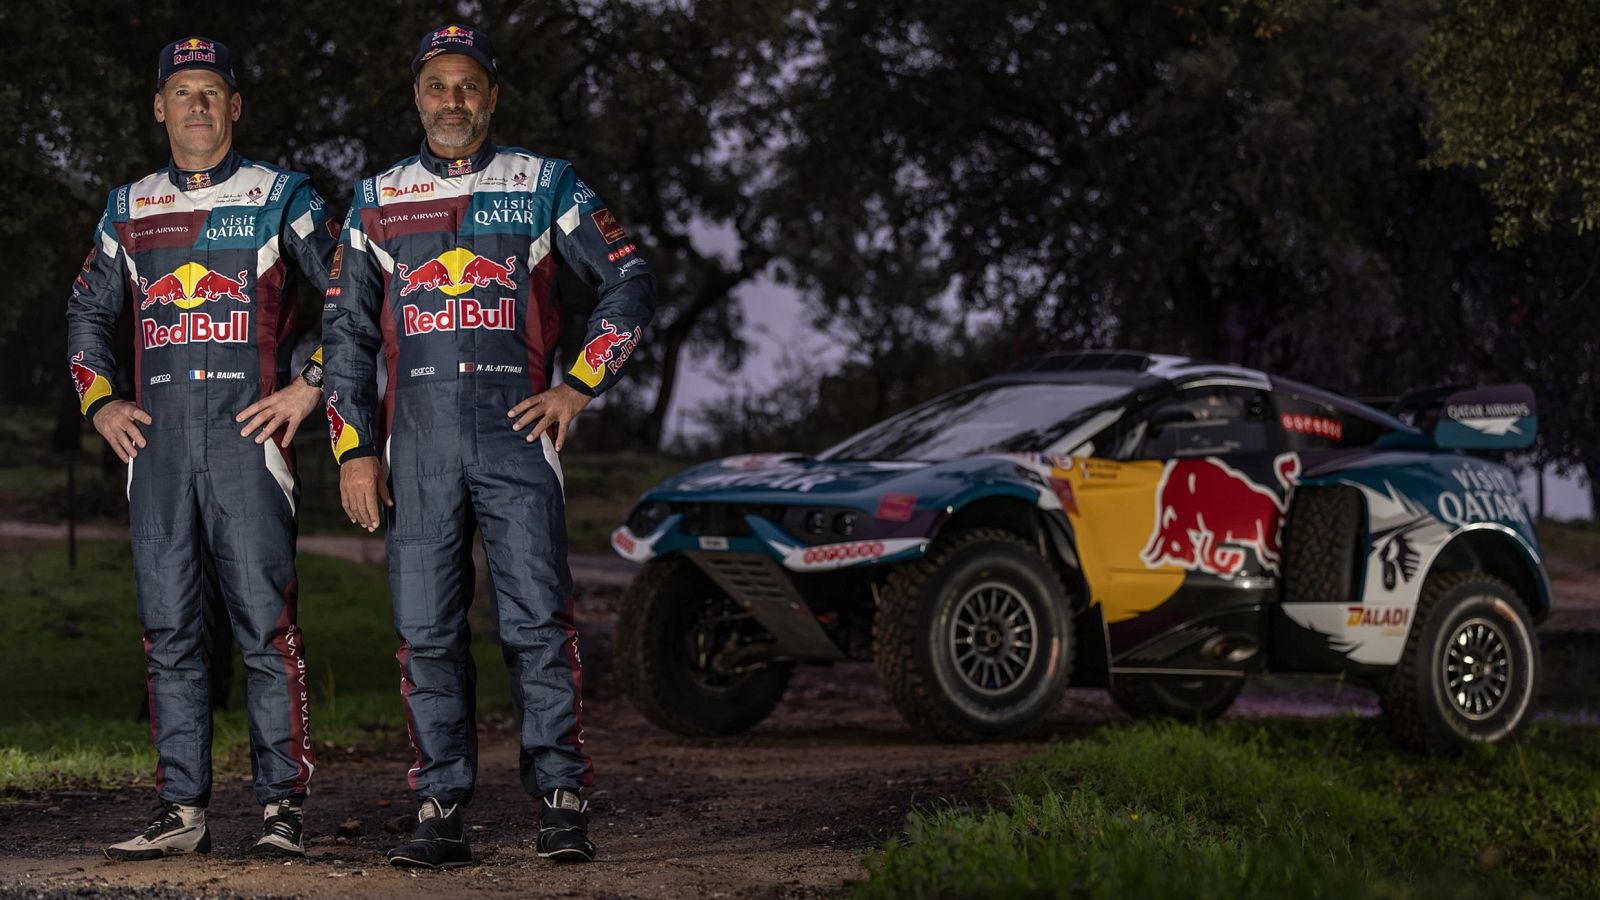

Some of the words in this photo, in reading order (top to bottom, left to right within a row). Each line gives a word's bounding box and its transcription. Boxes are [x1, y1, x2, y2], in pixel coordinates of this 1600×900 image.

[174, 51, 193, 65] Red
[195, 51, 215, 63] Bull
[540, 160, 556, 188] sparco
[269, 174, 289, 202] sparco
[493, 196, 534, 211] visit
[222, 214, 256, 225] visit
[380, 213, 409, 225] QATAR
[410, 211, 449, 221] AIRWAYS
[474, 209, 534, 226] QATAR
[130, 229, 154, 239] QATAR
[155, 226, 189, 234] AIRWAYS
[206, 225, 254, 241] QATAR
[402, 299, 456, 337] Red
[459, 297, 516, 331] Bull
[142, 312, 188, 350] Red
[190, 310, 249, 343] Bull
[607, 346, 630, 376] Red
[624, 325, 643, 355] Bull
[207, 371, 215, 379] M.
[216, 371, 245, 379] BAUMEL
[410, 366, 436, 377] sparco
[1437, 491, 1528, 527] QATAR
